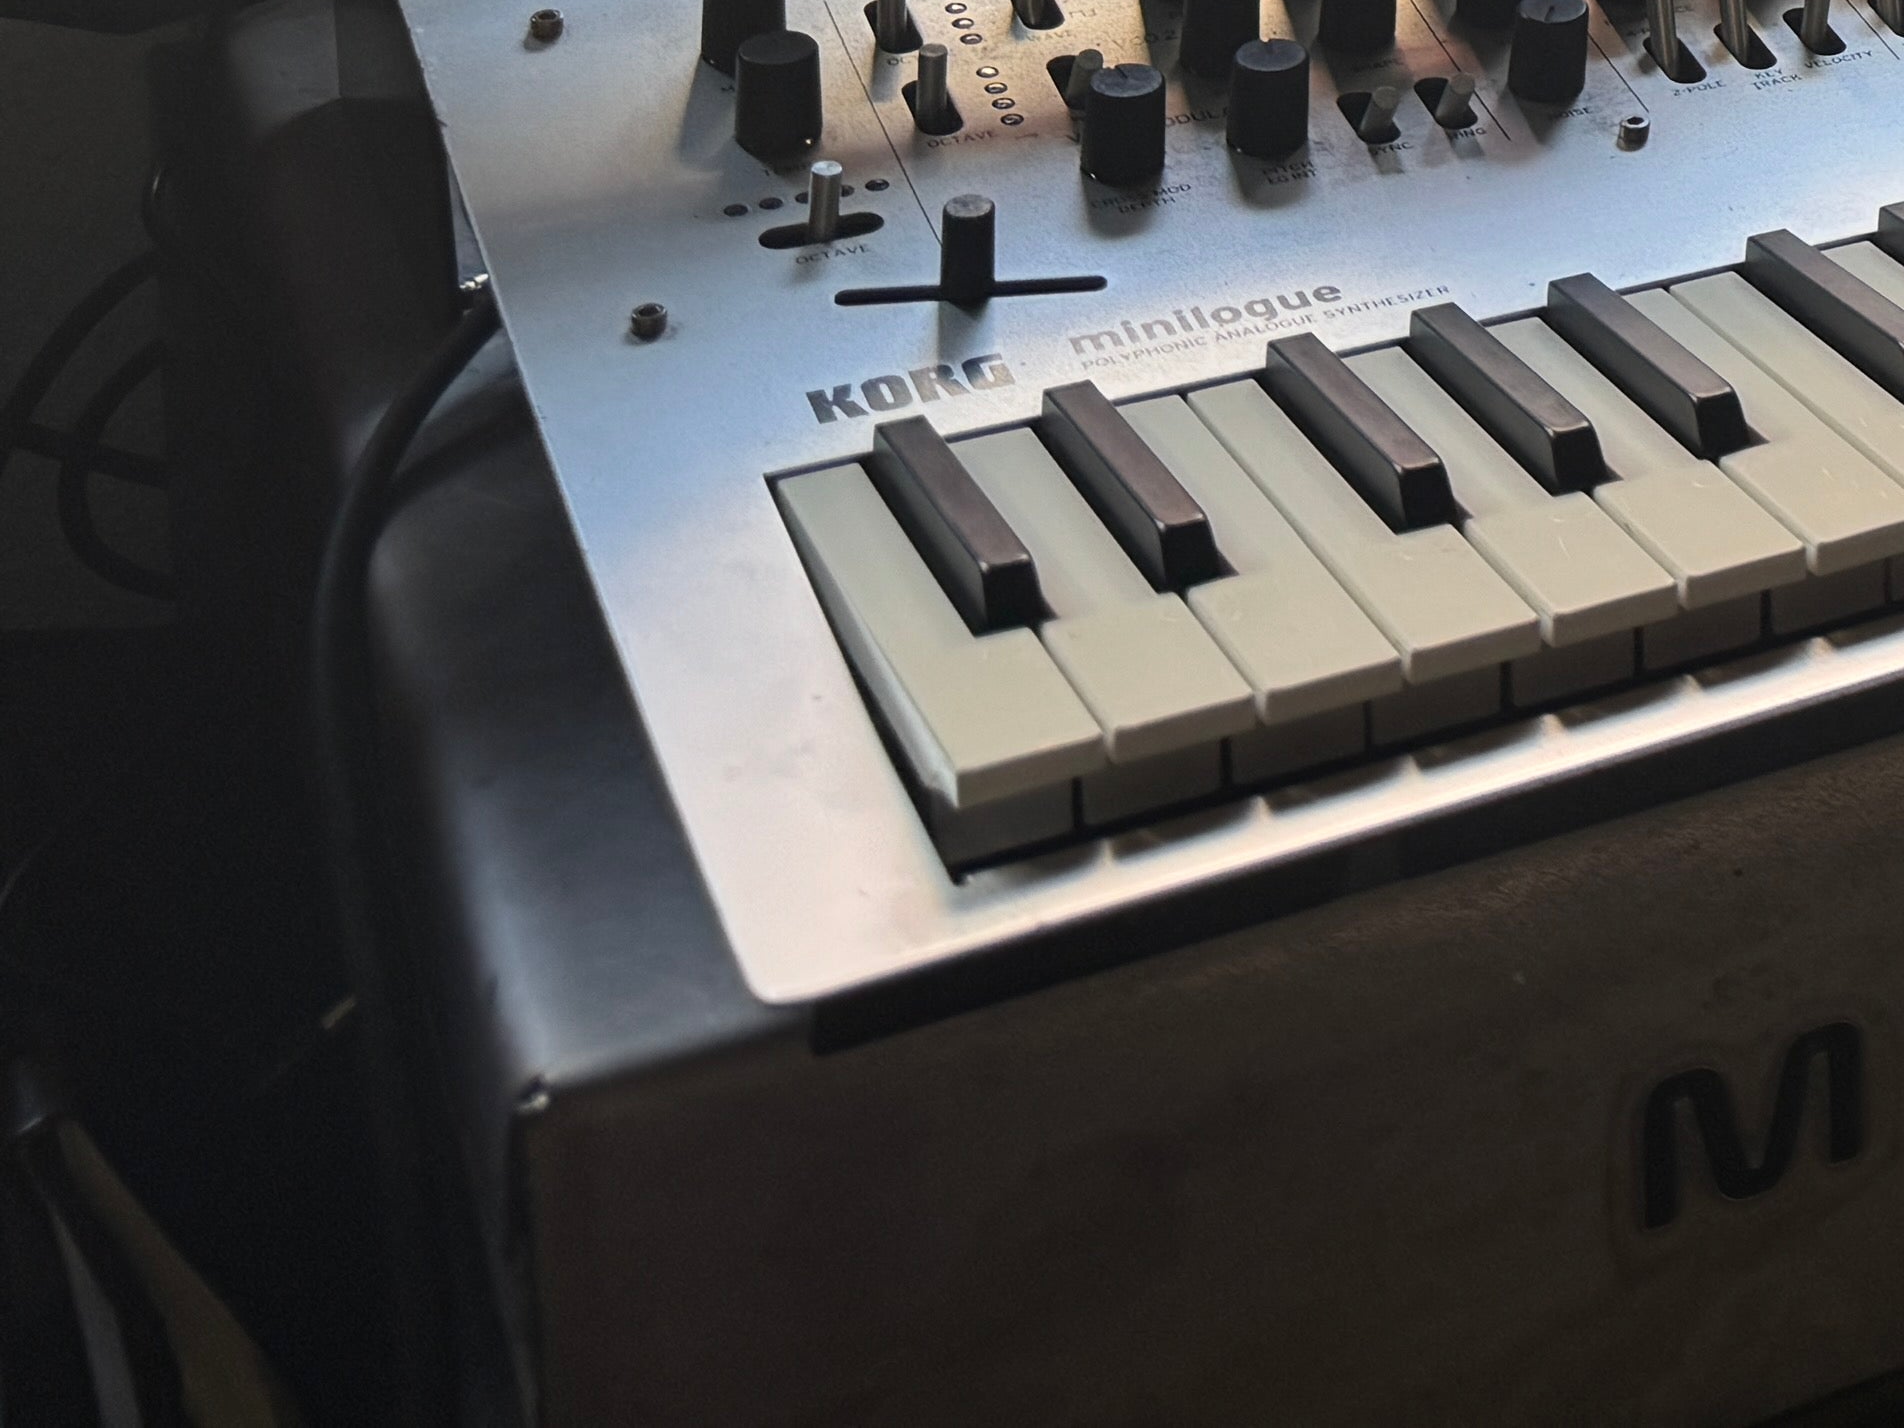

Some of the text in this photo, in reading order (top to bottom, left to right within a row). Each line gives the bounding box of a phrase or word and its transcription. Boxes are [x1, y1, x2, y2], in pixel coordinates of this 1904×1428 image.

[1804, 49, 1875, 70] VELOCITY
[1754, 67, 1784, 80] KEY
[1754, 72, 1804, 91] TRACK
[926, 130, 997, 149] OCTAVE
[1152, 182, 1192, 197] MOD
[795, 243, 869, 265] OCTAVE
[1080, 284, 1451, 372] POLYPHONIC ANALOGUE SYNTHESIZER
[805, 280, 1345, 425] KORG minilogue
